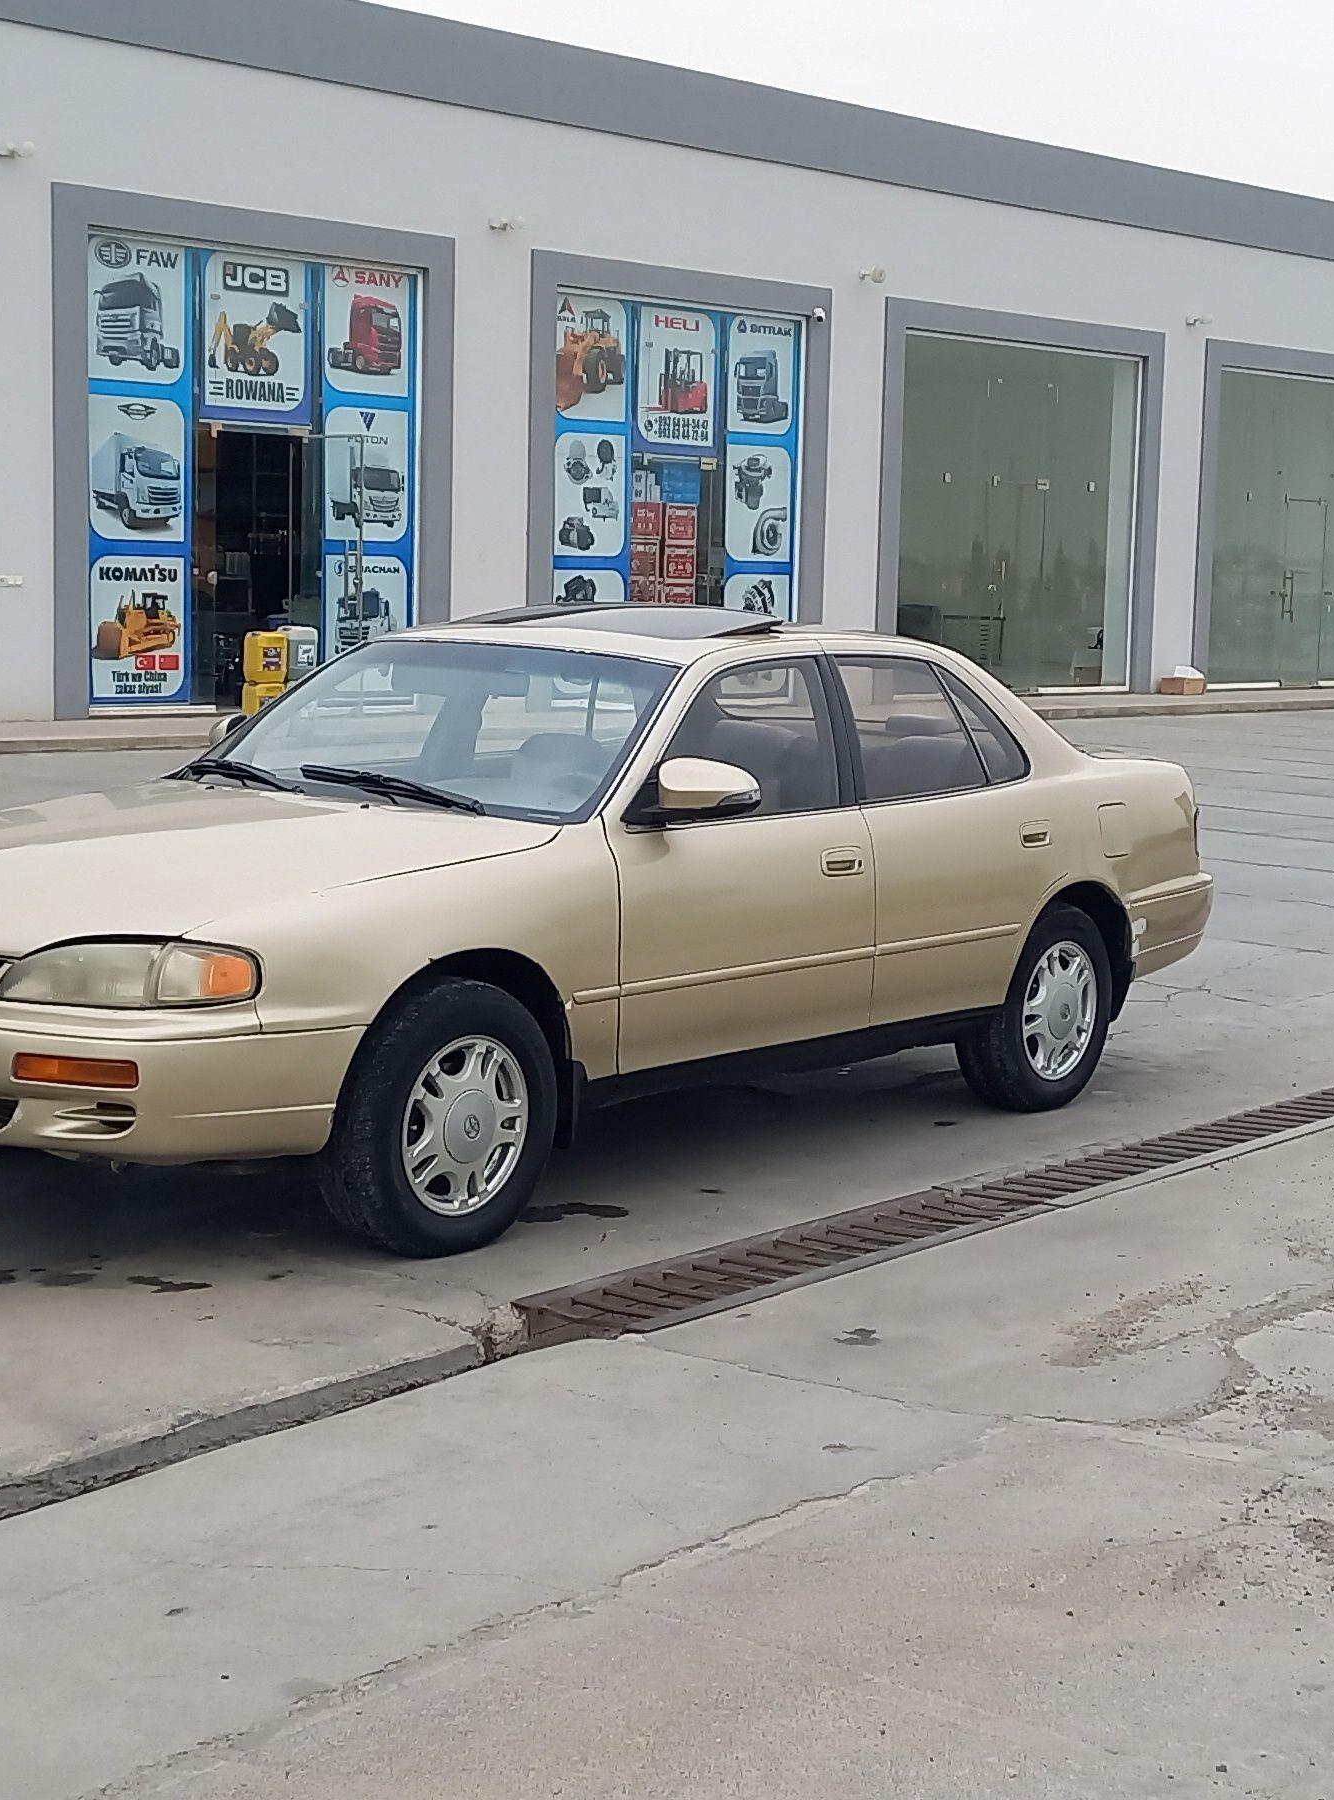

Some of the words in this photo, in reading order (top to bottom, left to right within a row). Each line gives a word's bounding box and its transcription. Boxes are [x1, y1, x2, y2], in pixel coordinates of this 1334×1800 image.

[136, 248, 179, 270] FAW
[225, 264, 287, 292] JCB
[354, 270, 403, 288] SANY
[654, 314, 700, 332] HELI
[225, 377, 286, 404] ROWANA
[347, 435, 388, 446] FOTON
[99, 563, 178, 583] KOMATSU
[348, 565, 400, 574] SACMAN
